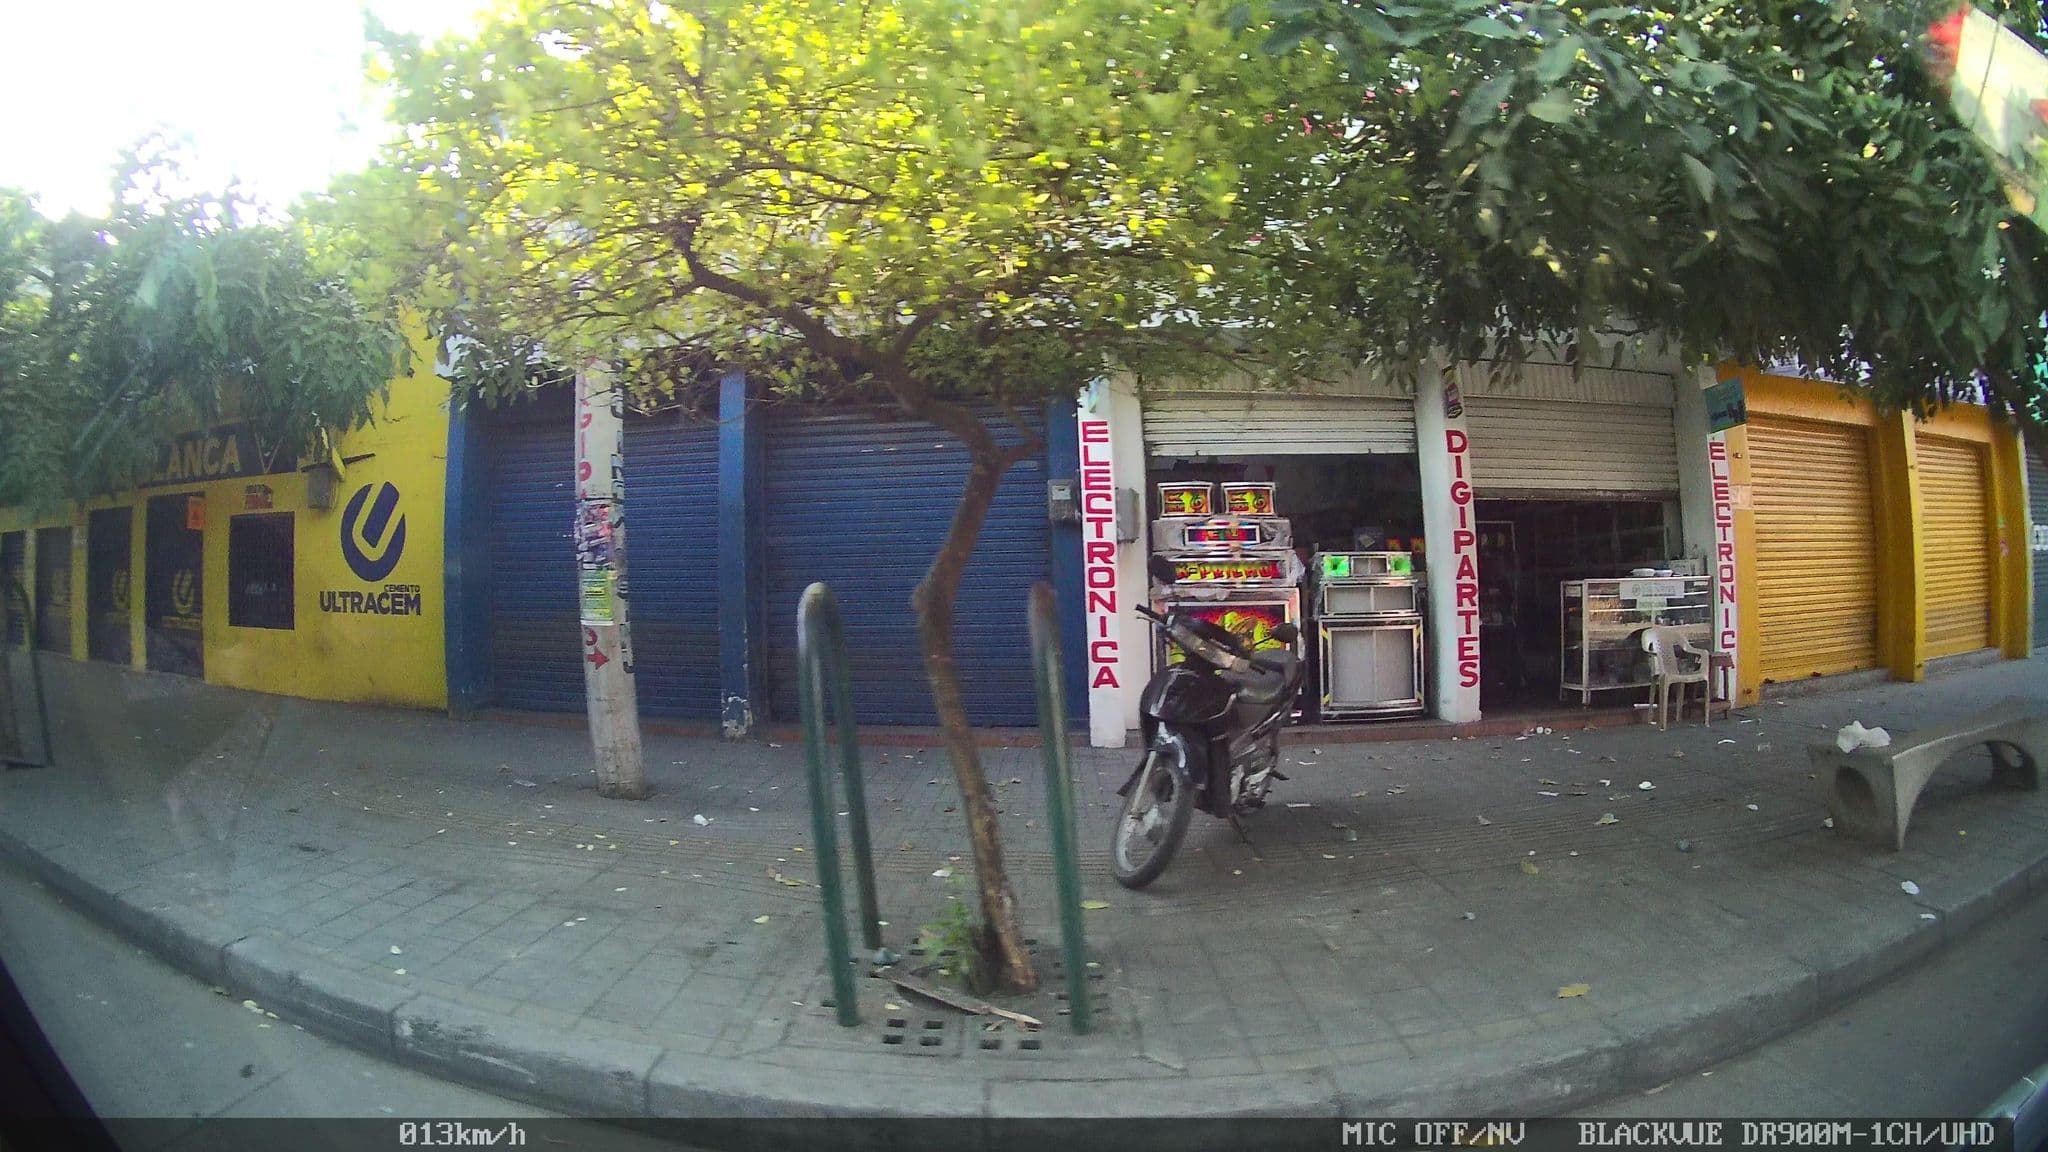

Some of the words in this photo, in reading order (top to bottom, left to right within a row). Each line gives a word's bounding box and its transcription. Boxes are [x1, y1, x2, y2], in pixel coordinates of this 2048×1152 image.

[319, 591, 421, 615] ULTRACEM
[384, 584, 420, 592] CEMENTO
[1081, 421, 1120, 689] ELECTRONICA
[1446, 429, 1479, 688] DIGIPARTES
[1709, 442, 1736, 670] ELECTRONIC
